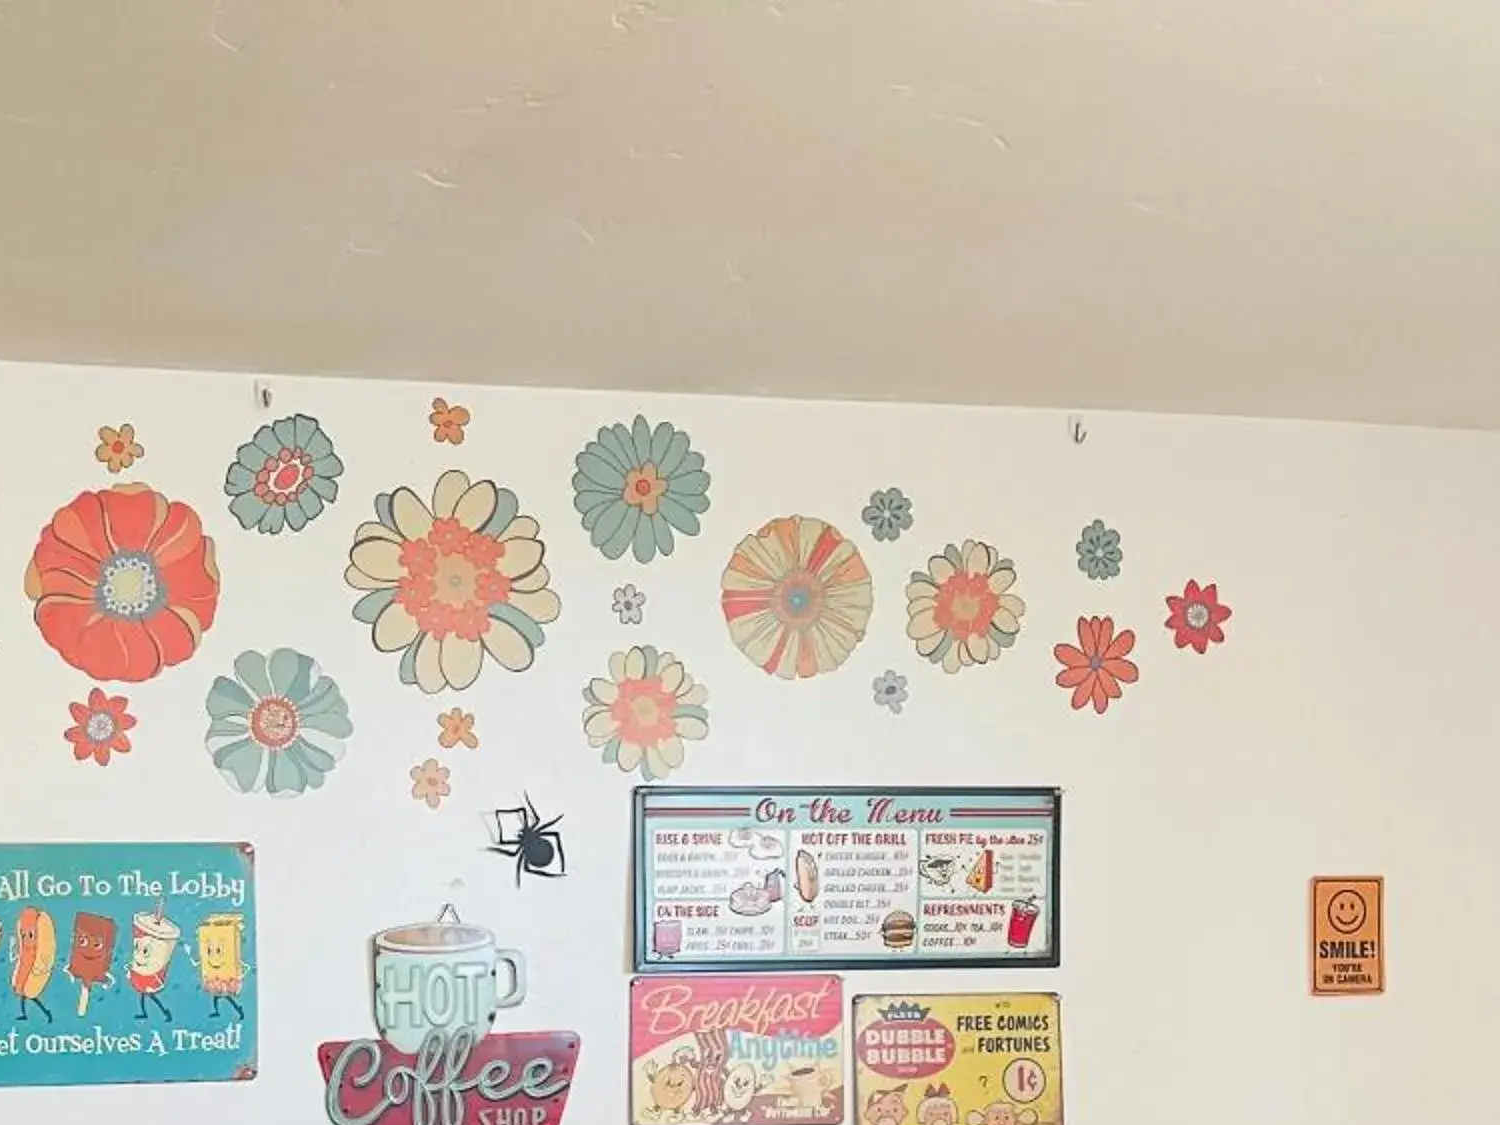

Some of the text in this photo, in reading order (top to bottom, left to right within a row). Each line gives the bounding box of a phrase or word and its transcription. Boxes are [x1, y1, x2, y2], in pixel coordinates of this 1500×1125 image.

[755, 796, 943, 824] On the Menu
[801, 832, 908, 846] HOT OFF THE GRILL
[925, 832, 957, 845] FRESH
[959, 833, 974, 845] PIE
[989, 834, 1004, 845] the
[37, 874, 73, 897] Go
[79, 874, 111, 897] To
[118, 872, 162, 897] The
[169, 870, 246, 906] Lobby
[674, 905, 693, 918] THE
[694, 905, 720, 918] SIDE
[923, 902, 1006, 916] REFRESHMENTS
[1319, 940, 1376, 959] SMILE!
[1332, 963, 1363, 973] YOU'RE
[1336, 974, 1373, 984] CAMERA
[381, 961, 490, 1030] HOT
[641, 980, 832, 1036] Breakfast
[957, 1015, 1050, 1031] FREE COMICS
[25, 1025, 141, 1055] Ourselves
[147, 1030, 169, 1056] A
[172, 1023, 242, 1051] Treat!
[864, 1028, 946, 1046] DUBBLE
[977, 1036, 1051, 1053] FORTUNES
[727, 1028, 839, 1070] Anytime
[866, 1047, 946, 1065] BUBBLE
[1016, 1064, 1039, 1093] 1¢
